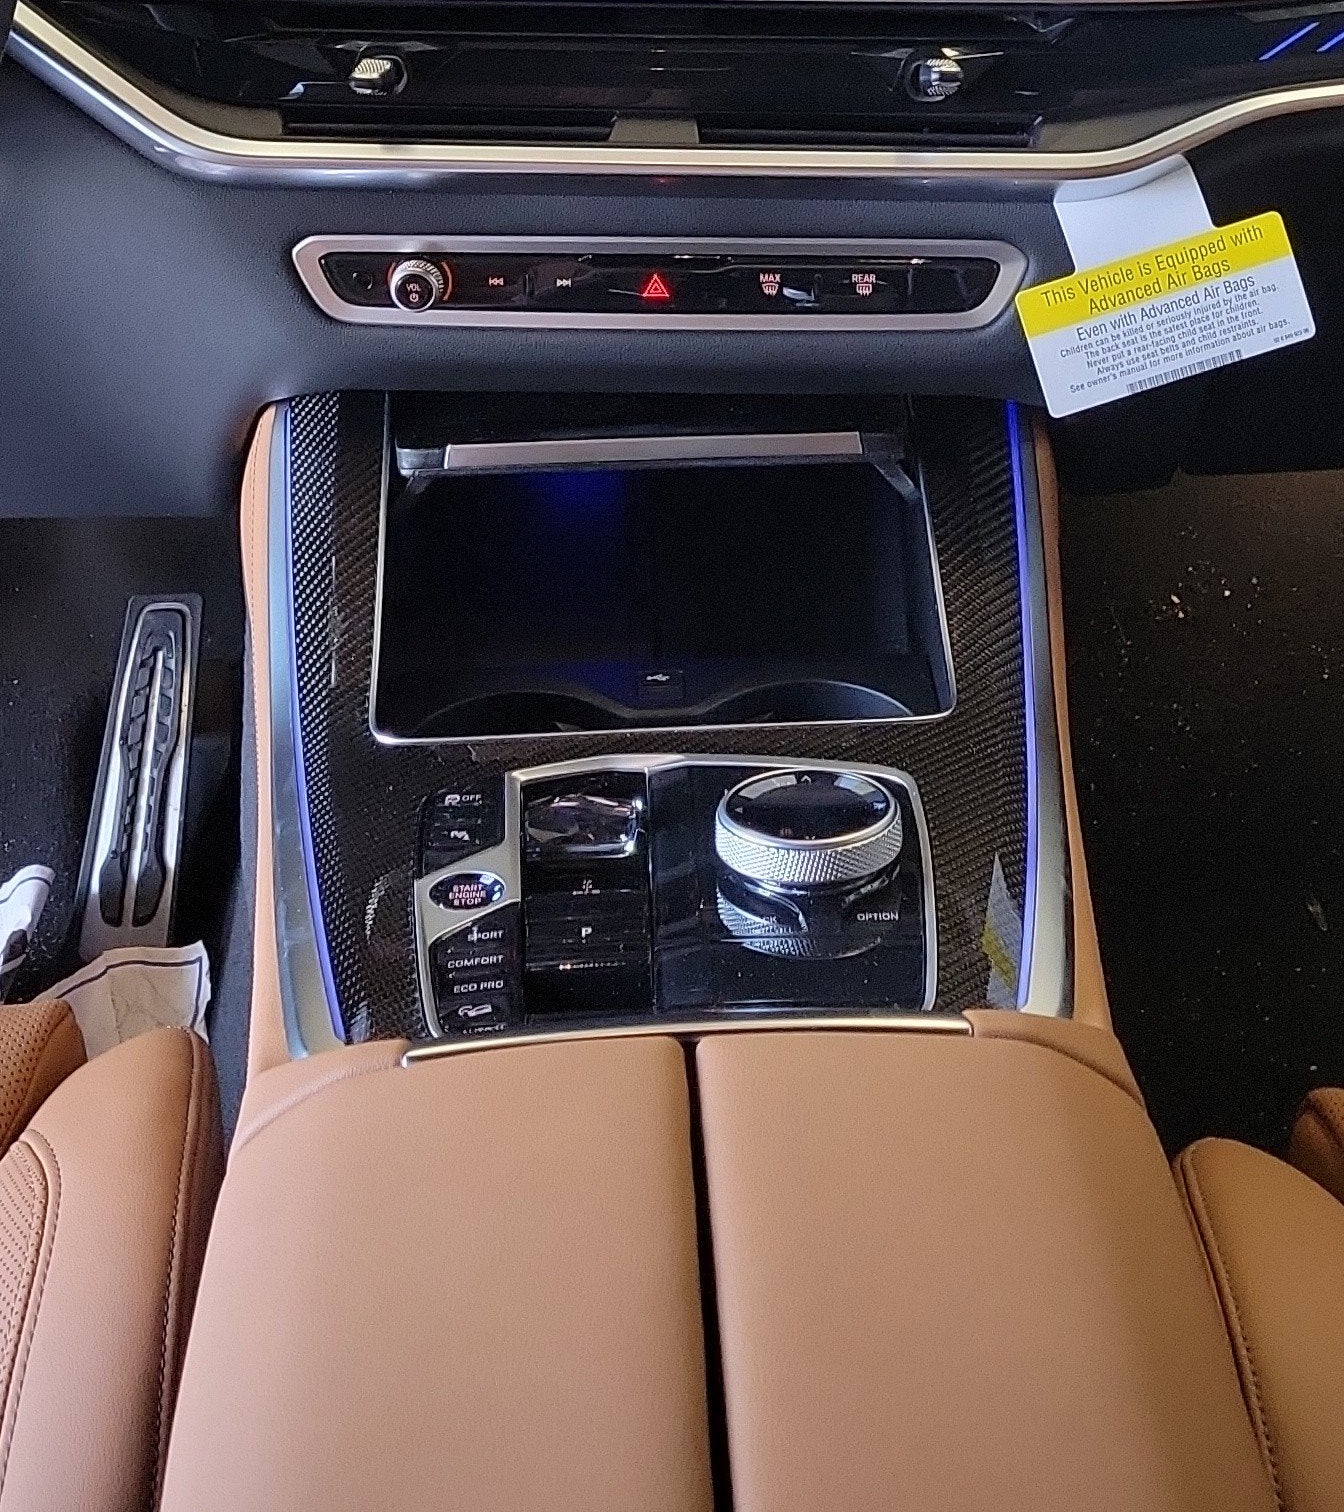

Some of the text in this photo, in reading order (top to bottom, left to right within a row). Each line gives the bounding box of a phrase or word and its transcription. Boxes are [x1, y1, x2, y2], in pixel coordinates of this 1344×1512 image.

[1041, 225, 1263, 306] This Vehicle is Equipped with
[759, 273, 781, 283] MAX
[852, 273, 876, 283] REAR
[406, 283, 421, 292] VOL
[1090, 260, 1230, 314] Advanced Air Bags
[1076, 276, 1254, 341] Even with Advanced Air Bags
[1060, 343, 1093, 357] Children
[1095, 337, 1109, 346] can
[1111, 333, 1120, 341] be
[1122, 325, 1143, 337] killed
[1156, 311, 1191, 327] seriously
[1193, 300, 1221, 314] injured
[1223, 297, 1232, 306] by
[1234, 293, 1247, 302] the
[1249, 289, 1259, 297] air
[1261, 284, 1278, 293] bag.
[1084, 350, 1099, 359] The
[1101, 342, 1120, 354] back
[1122, 336, 1138, 347] seat
[1149, 330, 1161, 339] the
[1164, 321, 1187, 334] safest
[1189, 315, 1210, 327] place
[1211, 310, 1222, 319] for
[1225, 300, 1259, 314] children.
[1087, 356, 1108, 368] Never
[1111, 350, 1124, 362] put
[1134, 335, 1175, 353] rear-facing
[1178, 327, 1196, 339] child
[1199, 322, 1215, 332] seat
[1217, 319, 1224, 327] in
[1226, 315, 1239, 324] the
[1241, 307, 1263, 319] front.
[1097, 319, 1258, 375] Always use seat belts and child restraints.
[1070, 319, 1290, 393] See owner's manual for more information about air bags.
[462, 794, 482, 802] OFF
[449, 891, 487, 900] ENGINE
[452, 884, 483, 893] START
[453, 898, 482, 907] STOP
[856, 912, 899, 921] OPTION
[581, 927, 592, 938] P
[448, 954, 505, 969] COMFORT
[453, 979, 504, 994] ECO PRO
